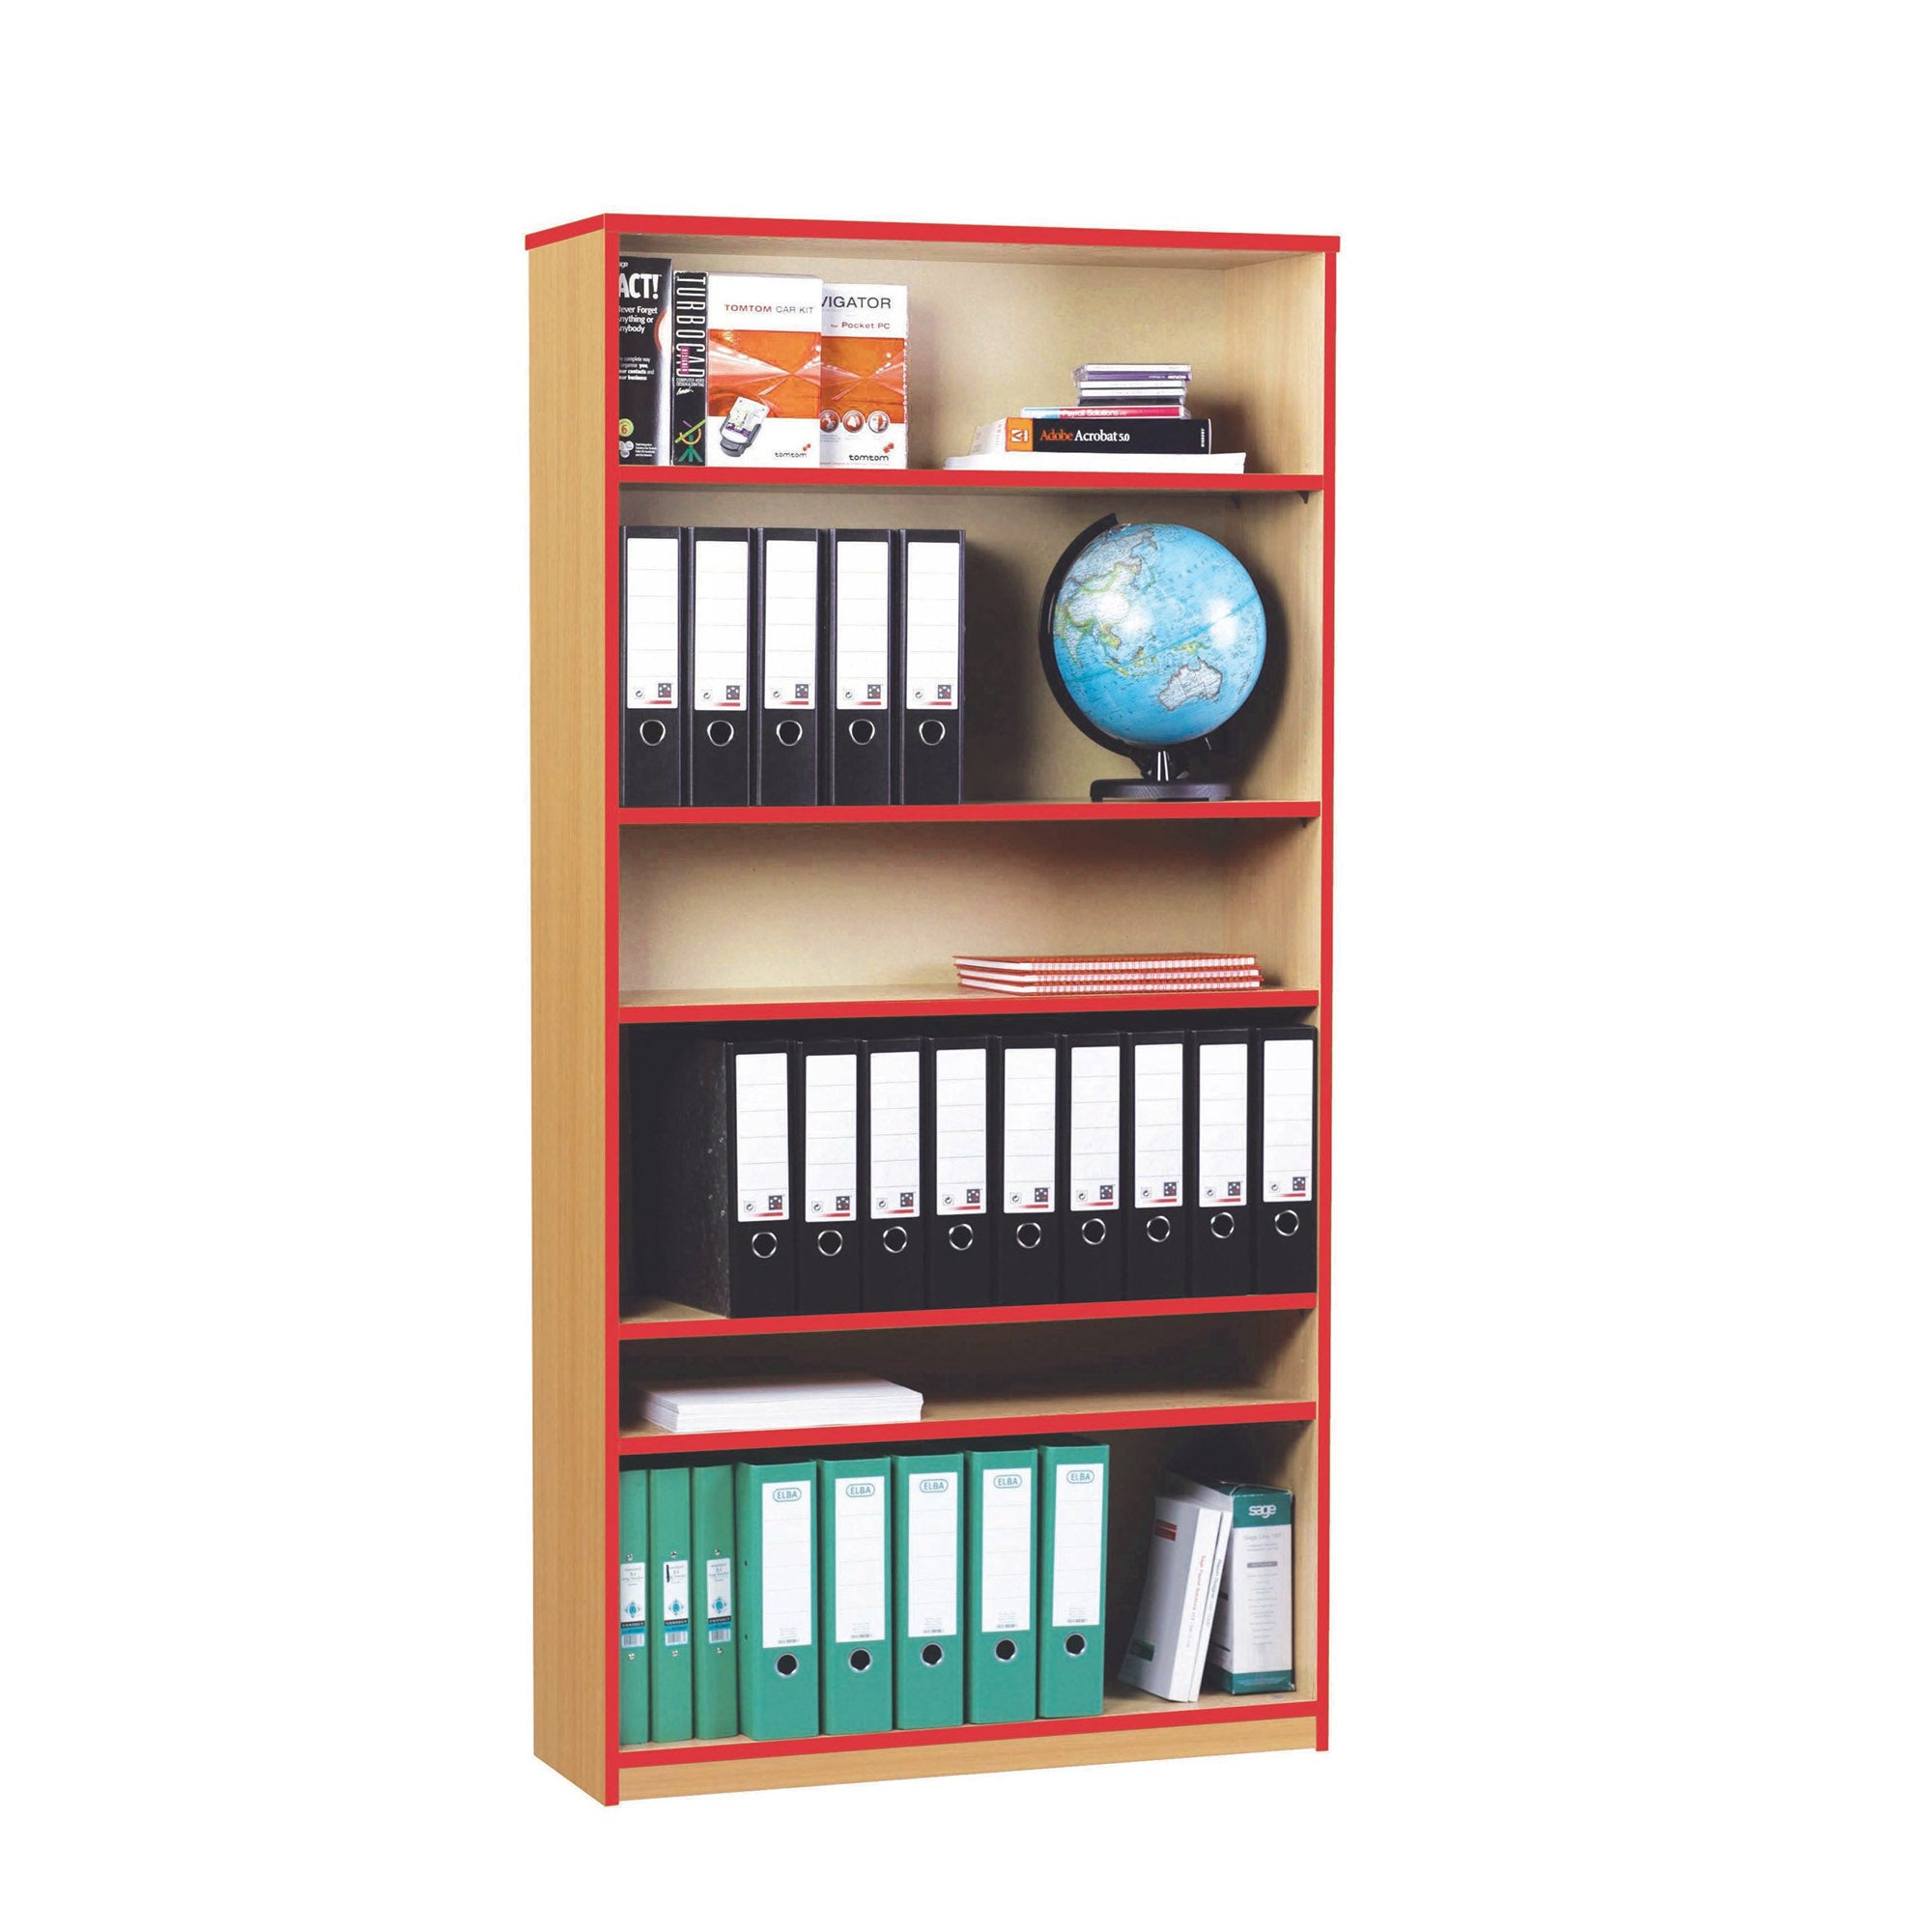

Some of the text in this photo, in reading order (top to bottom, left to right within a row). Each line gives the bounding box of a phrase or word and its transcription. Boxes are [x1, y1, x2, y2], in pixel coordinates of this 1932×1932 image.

[619, 272, 659, 300] ACT!
[637, 305, 658, 316] Forget
[724, 304, 773, 313] TOMTOM
[799, 306, 814, 315] KIT
[619, 315, 646, 325] nything
[619, 325, 645, 334] nybody
[676, 276, 706, 378] TURBOCAD
[1039, 429, 1130, 442] Adobe Acrobat 5.0
[998, 1477, 1018, 1486] ELBA
[1070, 1472, 1091, 1481] ELBA
[850, 1486, 871, 1495] ELBA
[923, 1480, 945, 1491] ELBA
[777, 1490, 798, 1499] ELBA
[1248, 1504, 1277, 1520] sage
